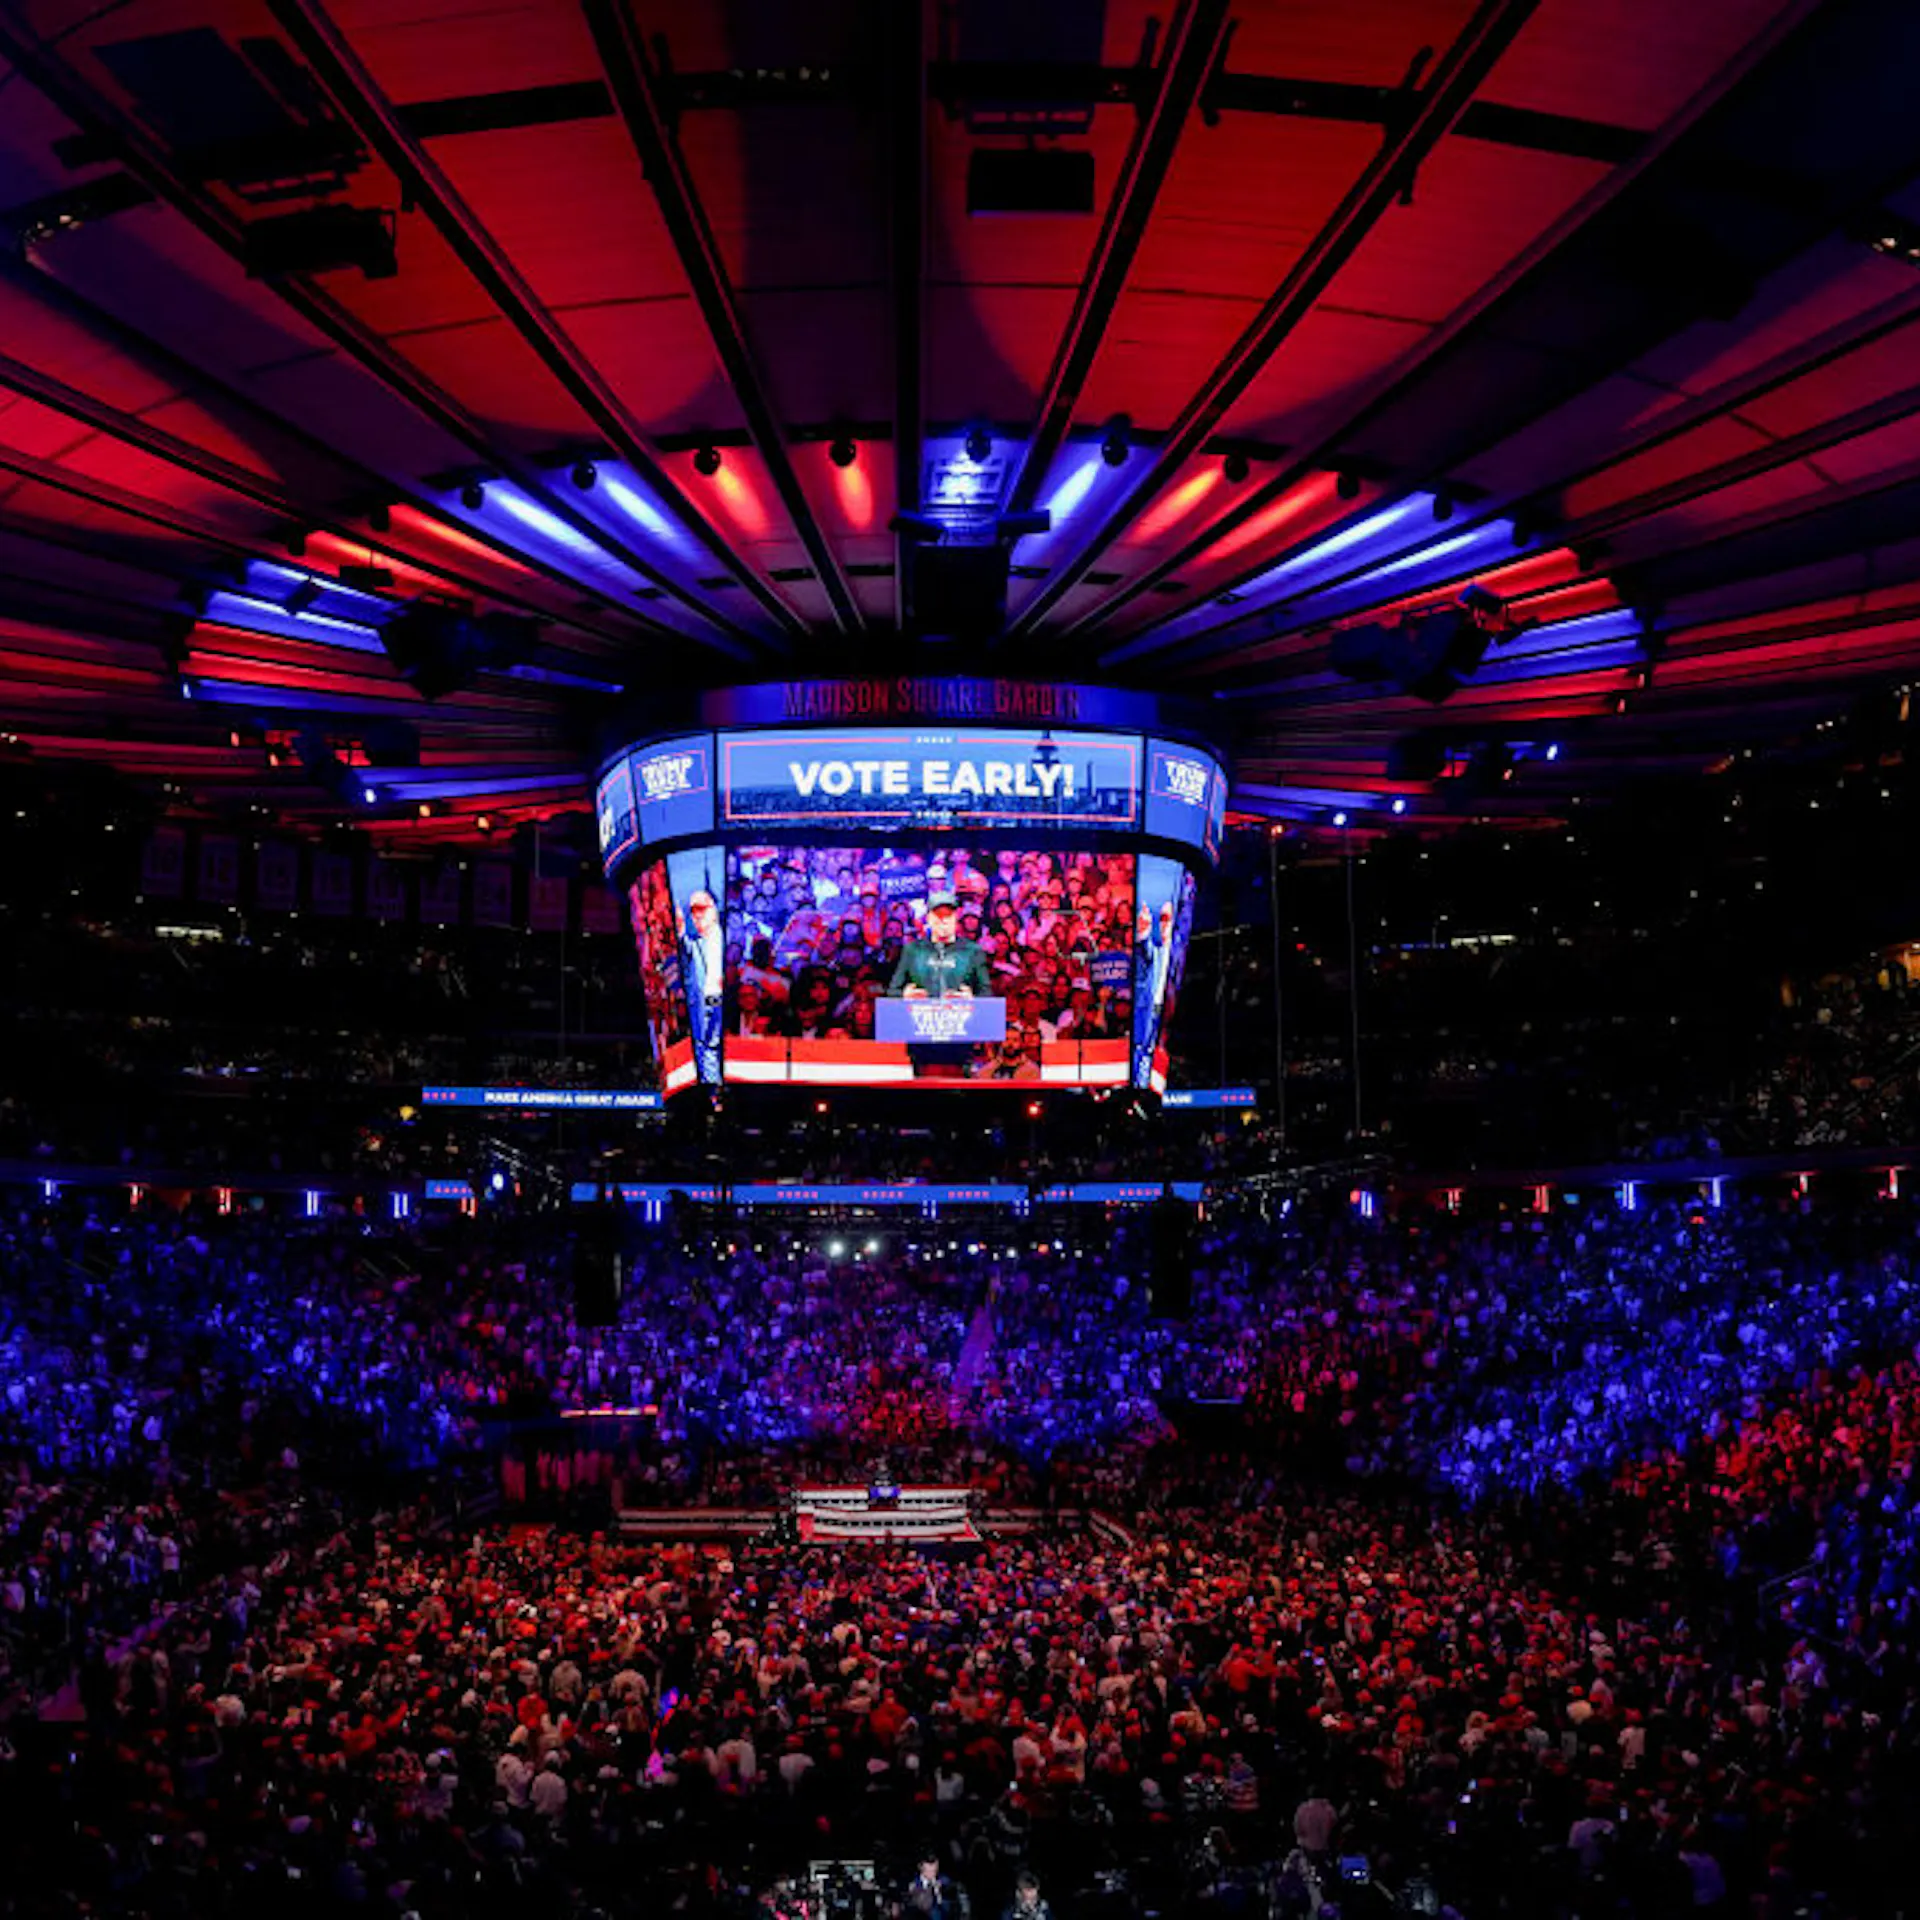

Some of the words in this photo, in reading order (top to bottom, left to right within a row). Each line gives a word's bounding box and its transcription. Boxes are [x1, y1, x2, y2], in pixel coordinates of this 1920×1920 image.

[782, 681, 890, 716] MADISON
[789, 761, 910, 797] VOTE
[922, 761, 1075, 798] EARLY!
[484, 1092, 520, 1104] MAKE
[521, 1092, 573, 1105] AMERICA
[574, 1094, 612, 1106] GREAT
